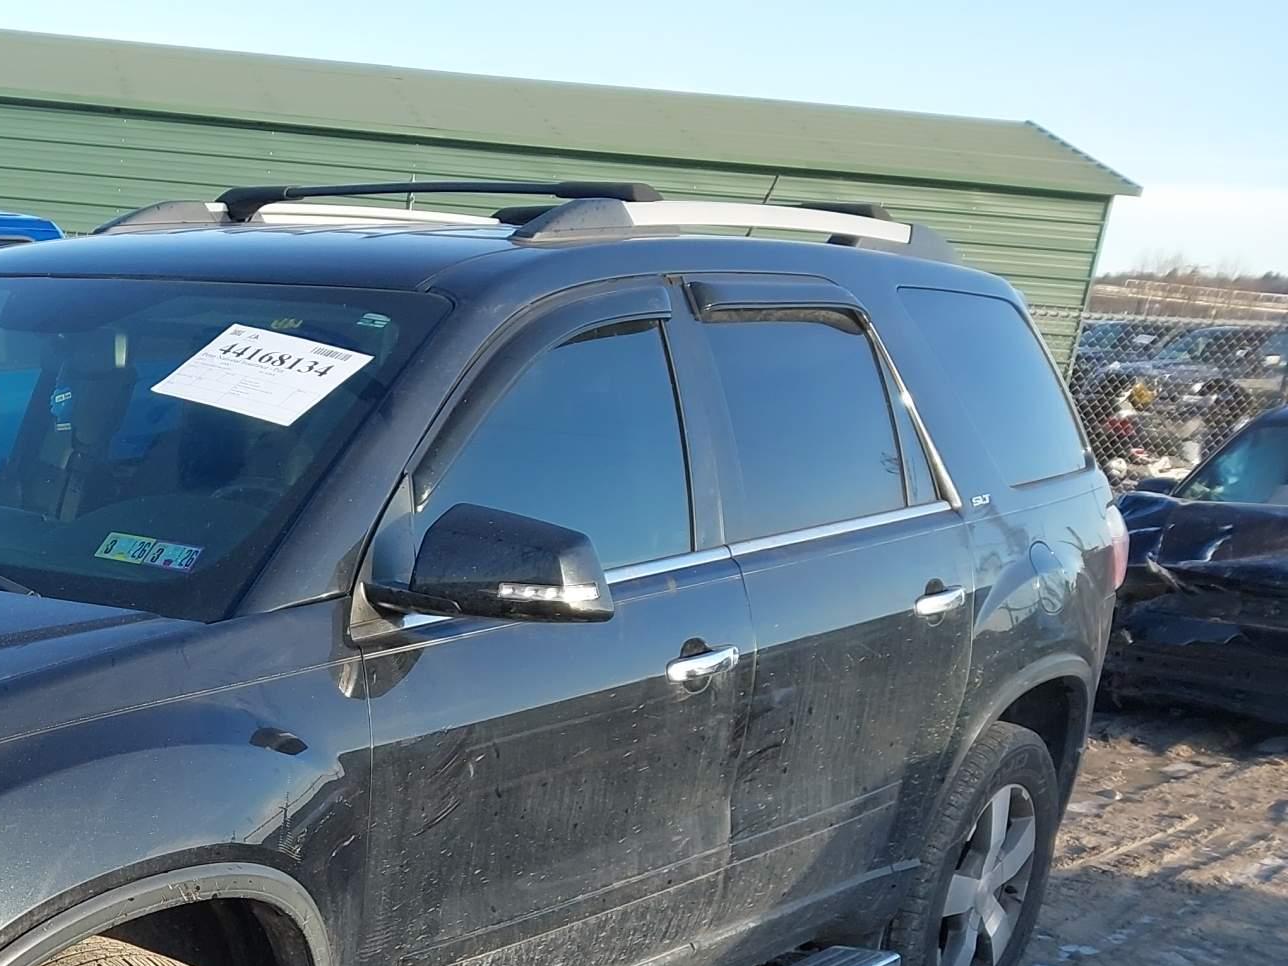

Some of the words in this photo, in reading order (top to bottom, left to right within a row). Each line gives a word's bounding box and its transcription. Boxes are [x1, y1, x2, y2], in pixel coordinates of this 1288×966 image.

[219, 343, 336, 377] 44168134
[972, 493, 992, 507] SLT
[103, 539, 118, 555] 3
[131, 541, 152, 560] 26
[151, 547, 165, 563] 3
[178, 549, 200, 568] 26
